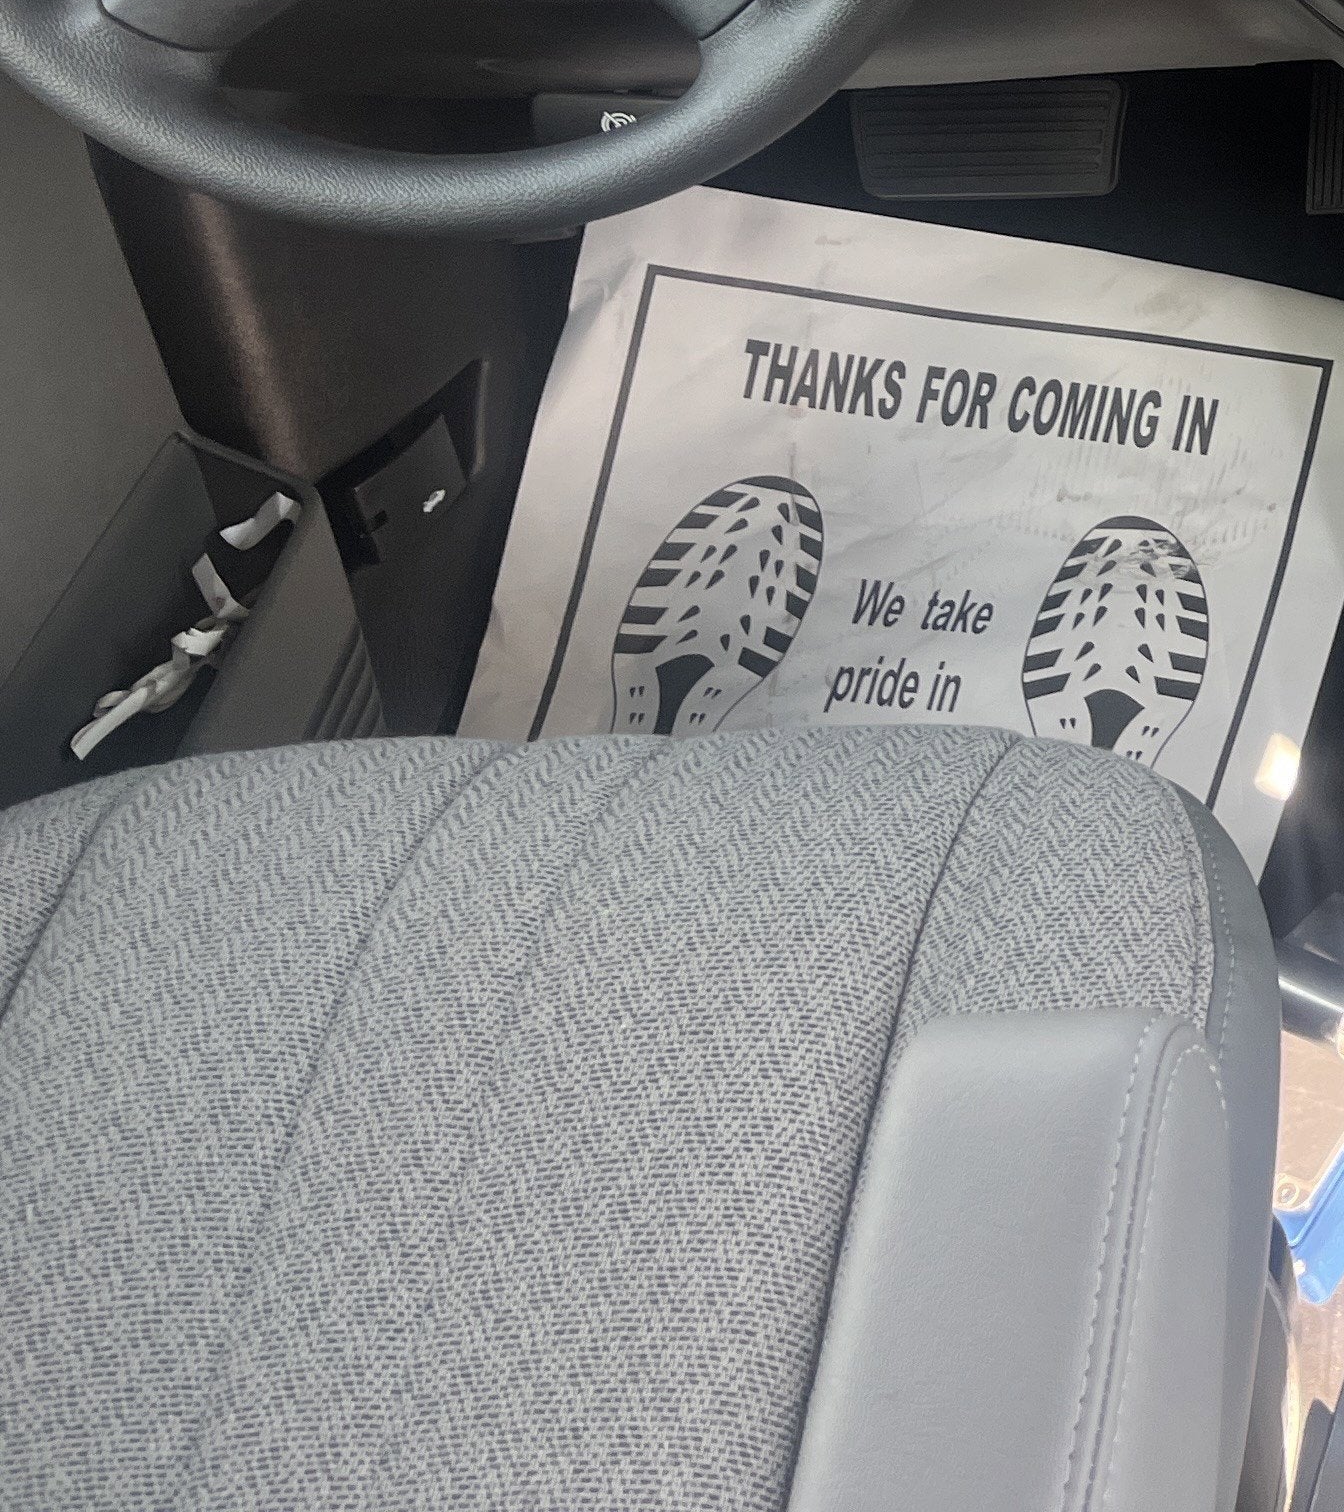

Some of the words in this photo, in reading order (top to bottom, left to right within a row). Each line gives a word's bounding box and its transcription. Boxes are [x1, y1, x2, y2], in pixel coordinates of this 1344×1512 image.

[741, 338, 905, 422] THANKS
[916, 365, 997, 431] FOR
[1006, 375, 1163, 449] COMING
[1173, 395, 1220, 456] IN
[851, 578, 907, 629] We
[920, 584, 994, 635] take
[825, 657, 920, 713] pride
[927, 662, 962, 713] in
